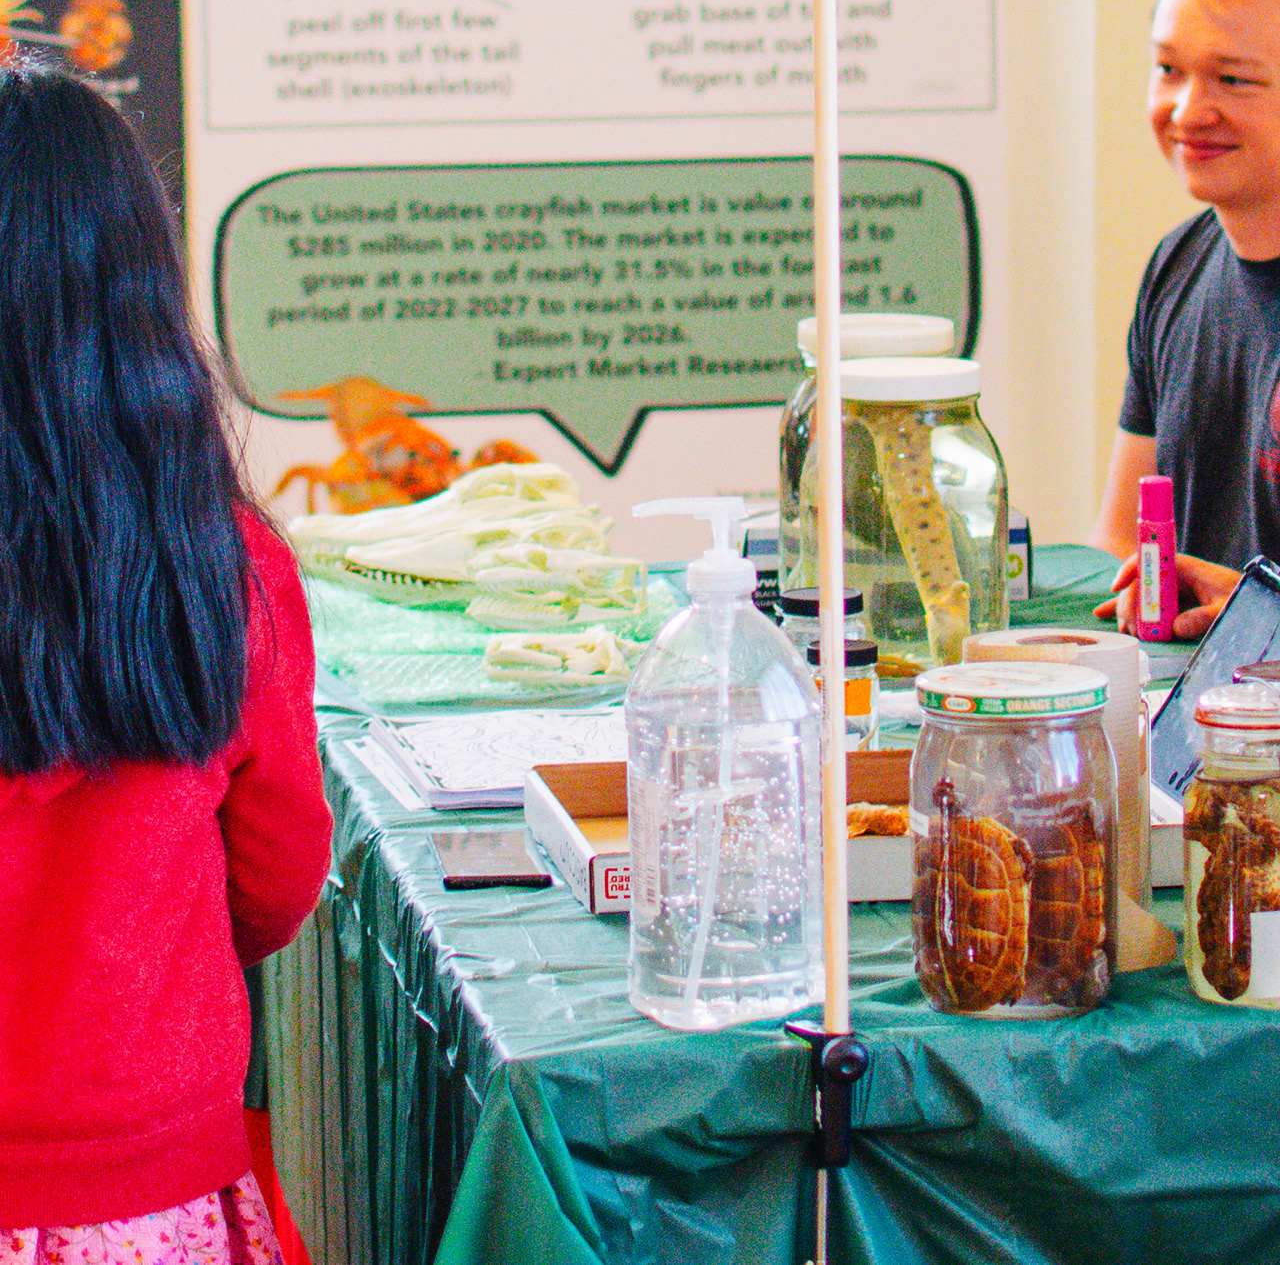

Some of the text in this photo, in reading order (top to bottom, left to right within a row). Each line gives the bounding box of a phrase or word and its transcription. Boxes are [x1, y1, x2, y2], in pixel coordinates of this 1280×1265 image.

[287, 6, 497, 39] peel off first few
[633, 0, 691, 30] grab
[698, 0, 757, 23] base
[267, 39, 520, 74] segments of the tail
[648, 34, 694, 61] pull
[703, 35, 765, 54] meat
[773, 35, 814, 53] out
[276, 76, 333, 101] shell
[659, 65, 744, 95] fingers
[752, 63, 778, 87] of
[256, 203, 303, 225] The
[311, 199, 399, 224] United
[405, 199, 486, 222] States
[493, 194, 593, 226] crayfish
[601, 191, 691, 216] market
[698, 192, 718, 214] is
[727, 191, 793, 213] value
[359, 232, 444, 255] million
[451, 232, 475, 254] in
[561, 227, 607, 249] The
[616, 226, 706, 248] market
[714, 226, 734, 247] is
[867, 222, 896, 244] to
[301, 271, 365, 297] grow
[375, 269, 402, 288] at
[409, 271, 424, 288] a
[431, 267, 484, 286] rate
[491, 260, 521, 285] of
[525, 259, 604, 288] nearly
[701, 259, 724, 279] in
[731, 256, 772, 278] the
[266, 300, 352, 329] period
[359, 298, 387, 322] of
[538, 296, 566, 316] to
[572, 293, 642, 314] reach
[651, 295, 666, 313] a
[673, 290, 739, 312] value
[748, 285, 776, 310] of
[495, 326, 574, 350] billion
[581, 325, 613, 352] by
[492, 360, 578, 384] Expert
[587, 355, 680, 379] Market
[1006, 698, 1052, 713] ORANGE
[610, 883, 631, 892] TRU
